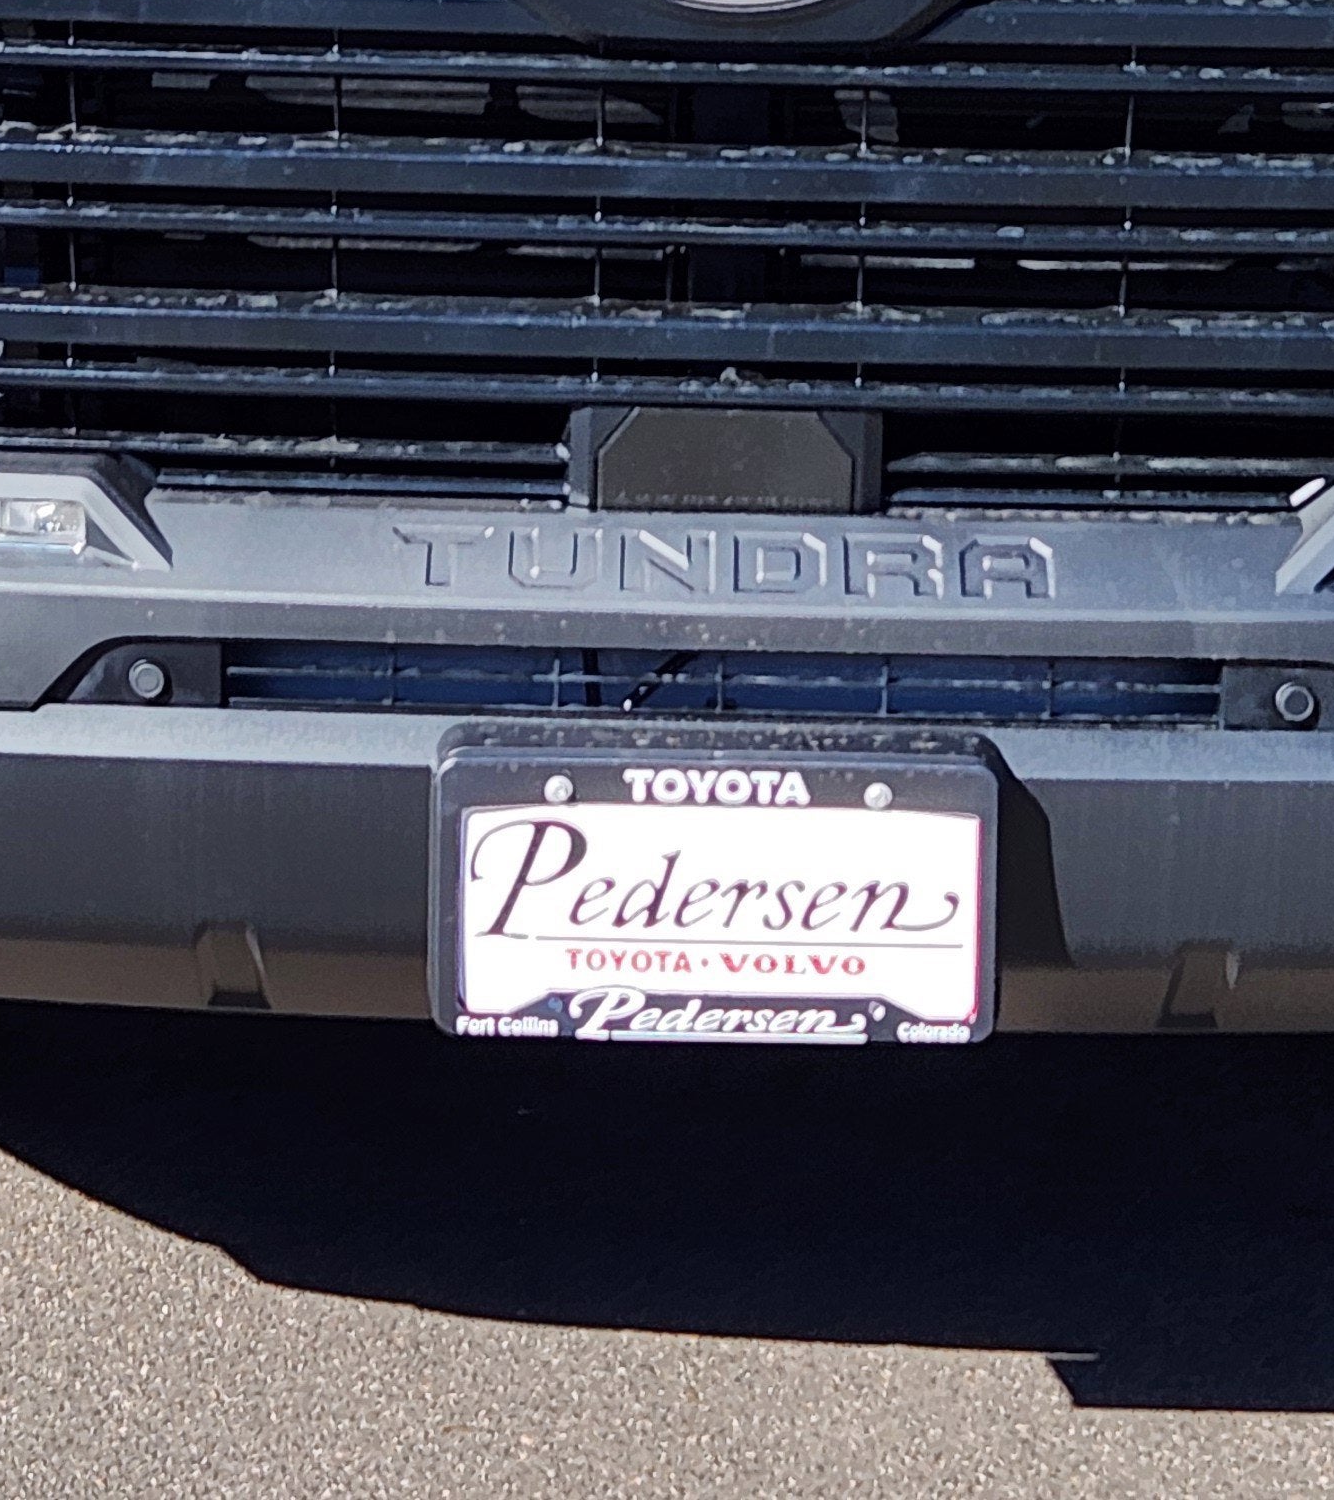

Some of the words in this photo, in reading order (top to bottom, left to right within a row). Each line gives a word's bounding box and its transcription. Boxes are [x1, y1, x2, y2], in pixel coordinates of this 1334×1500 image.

[391, 524, 1056, 599] TUNDRA
[622, 768, 811, 805] TOYOTA
[470, 819, 960, 938] Pedersen
[565, 948, 692, 973] TOYOTA
[719, 953, 866, 975] VOLVO
[456, 1016, 495, 1037] Fort
[498, 1016, 559, 1037] Collins
[568, 985, 868, 1040] Pedersen
[896, 1021, 971, 1044] Colorado
